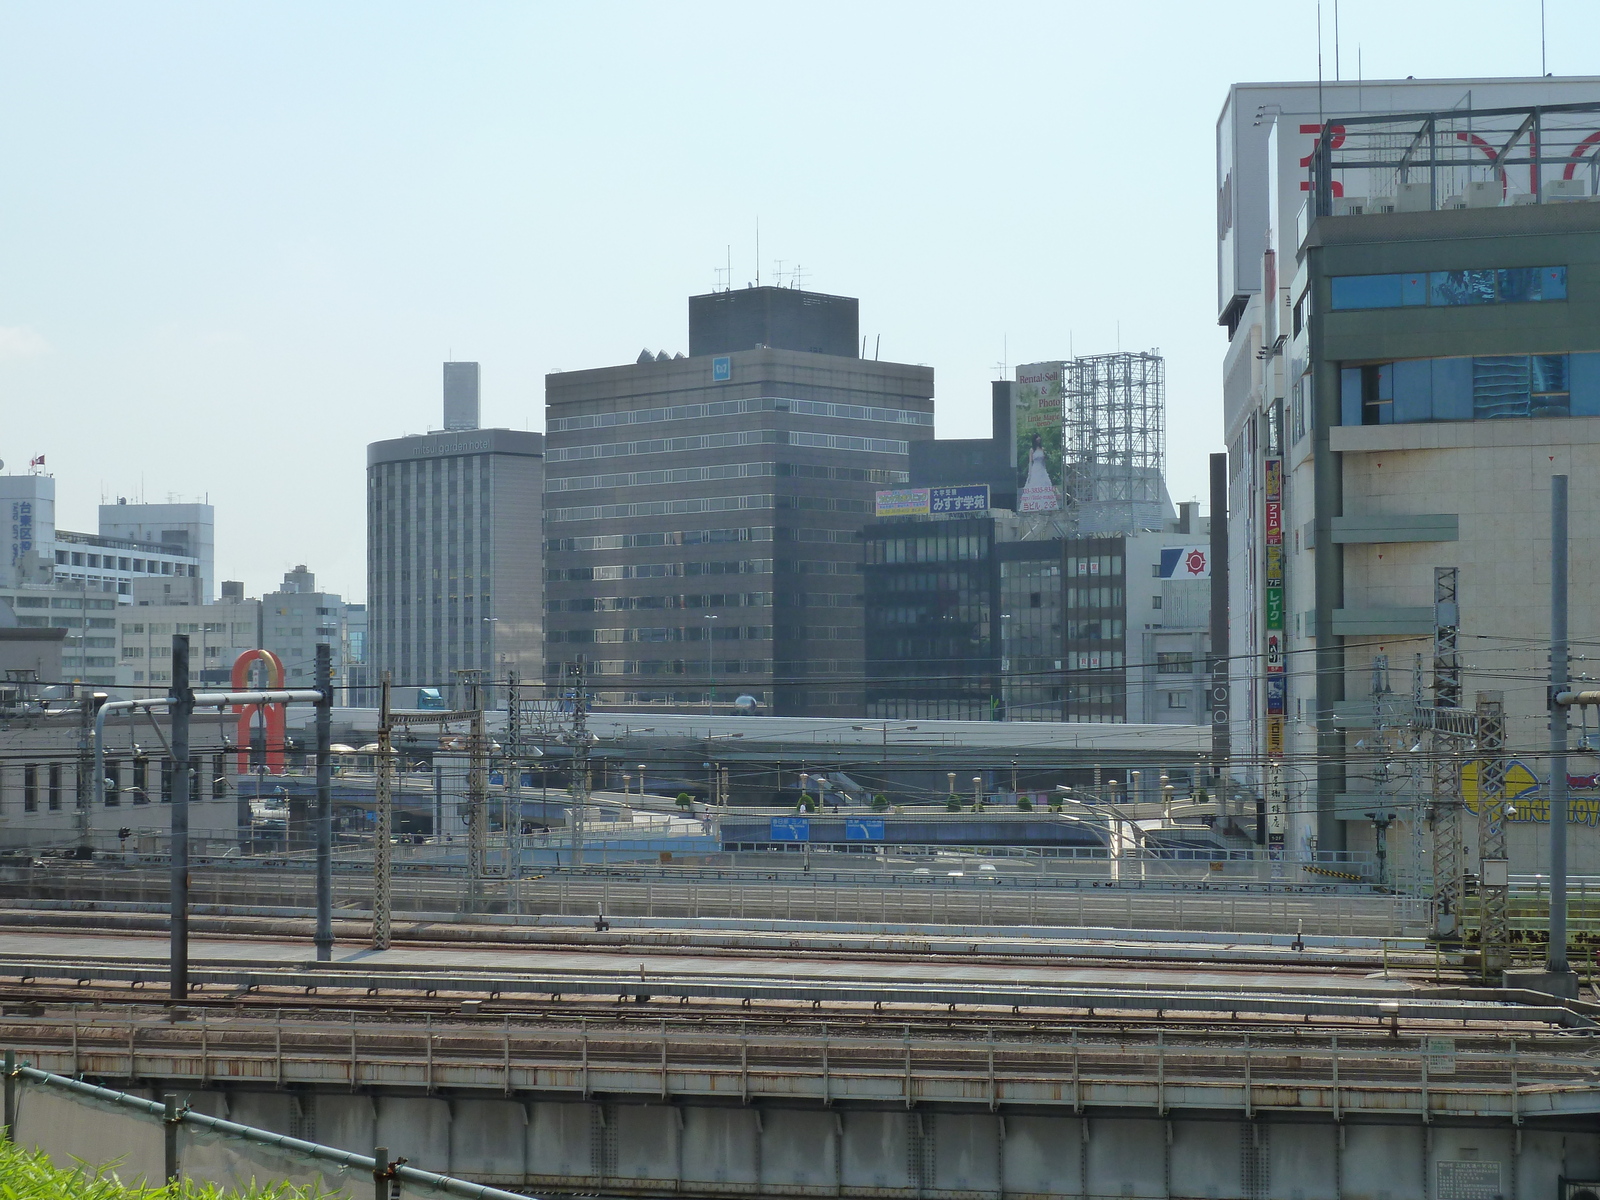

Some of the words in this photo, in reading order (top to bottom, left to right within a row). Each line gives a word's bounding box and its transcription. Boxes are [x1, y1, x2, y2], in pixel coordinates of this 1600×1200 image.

[1040, 386, 1047, 395] &
[1038, 399, 1061, 408] Photo
[412, 445, 439, 455] mitsui
[438, 440, 468, 455] garden
[469, 438, 492, 450] hotel
[1269, 504, 1278, 527] アコム
[1268, 579, 1281, 587] 7F
[1269, 590, 1280, 621] レイク
